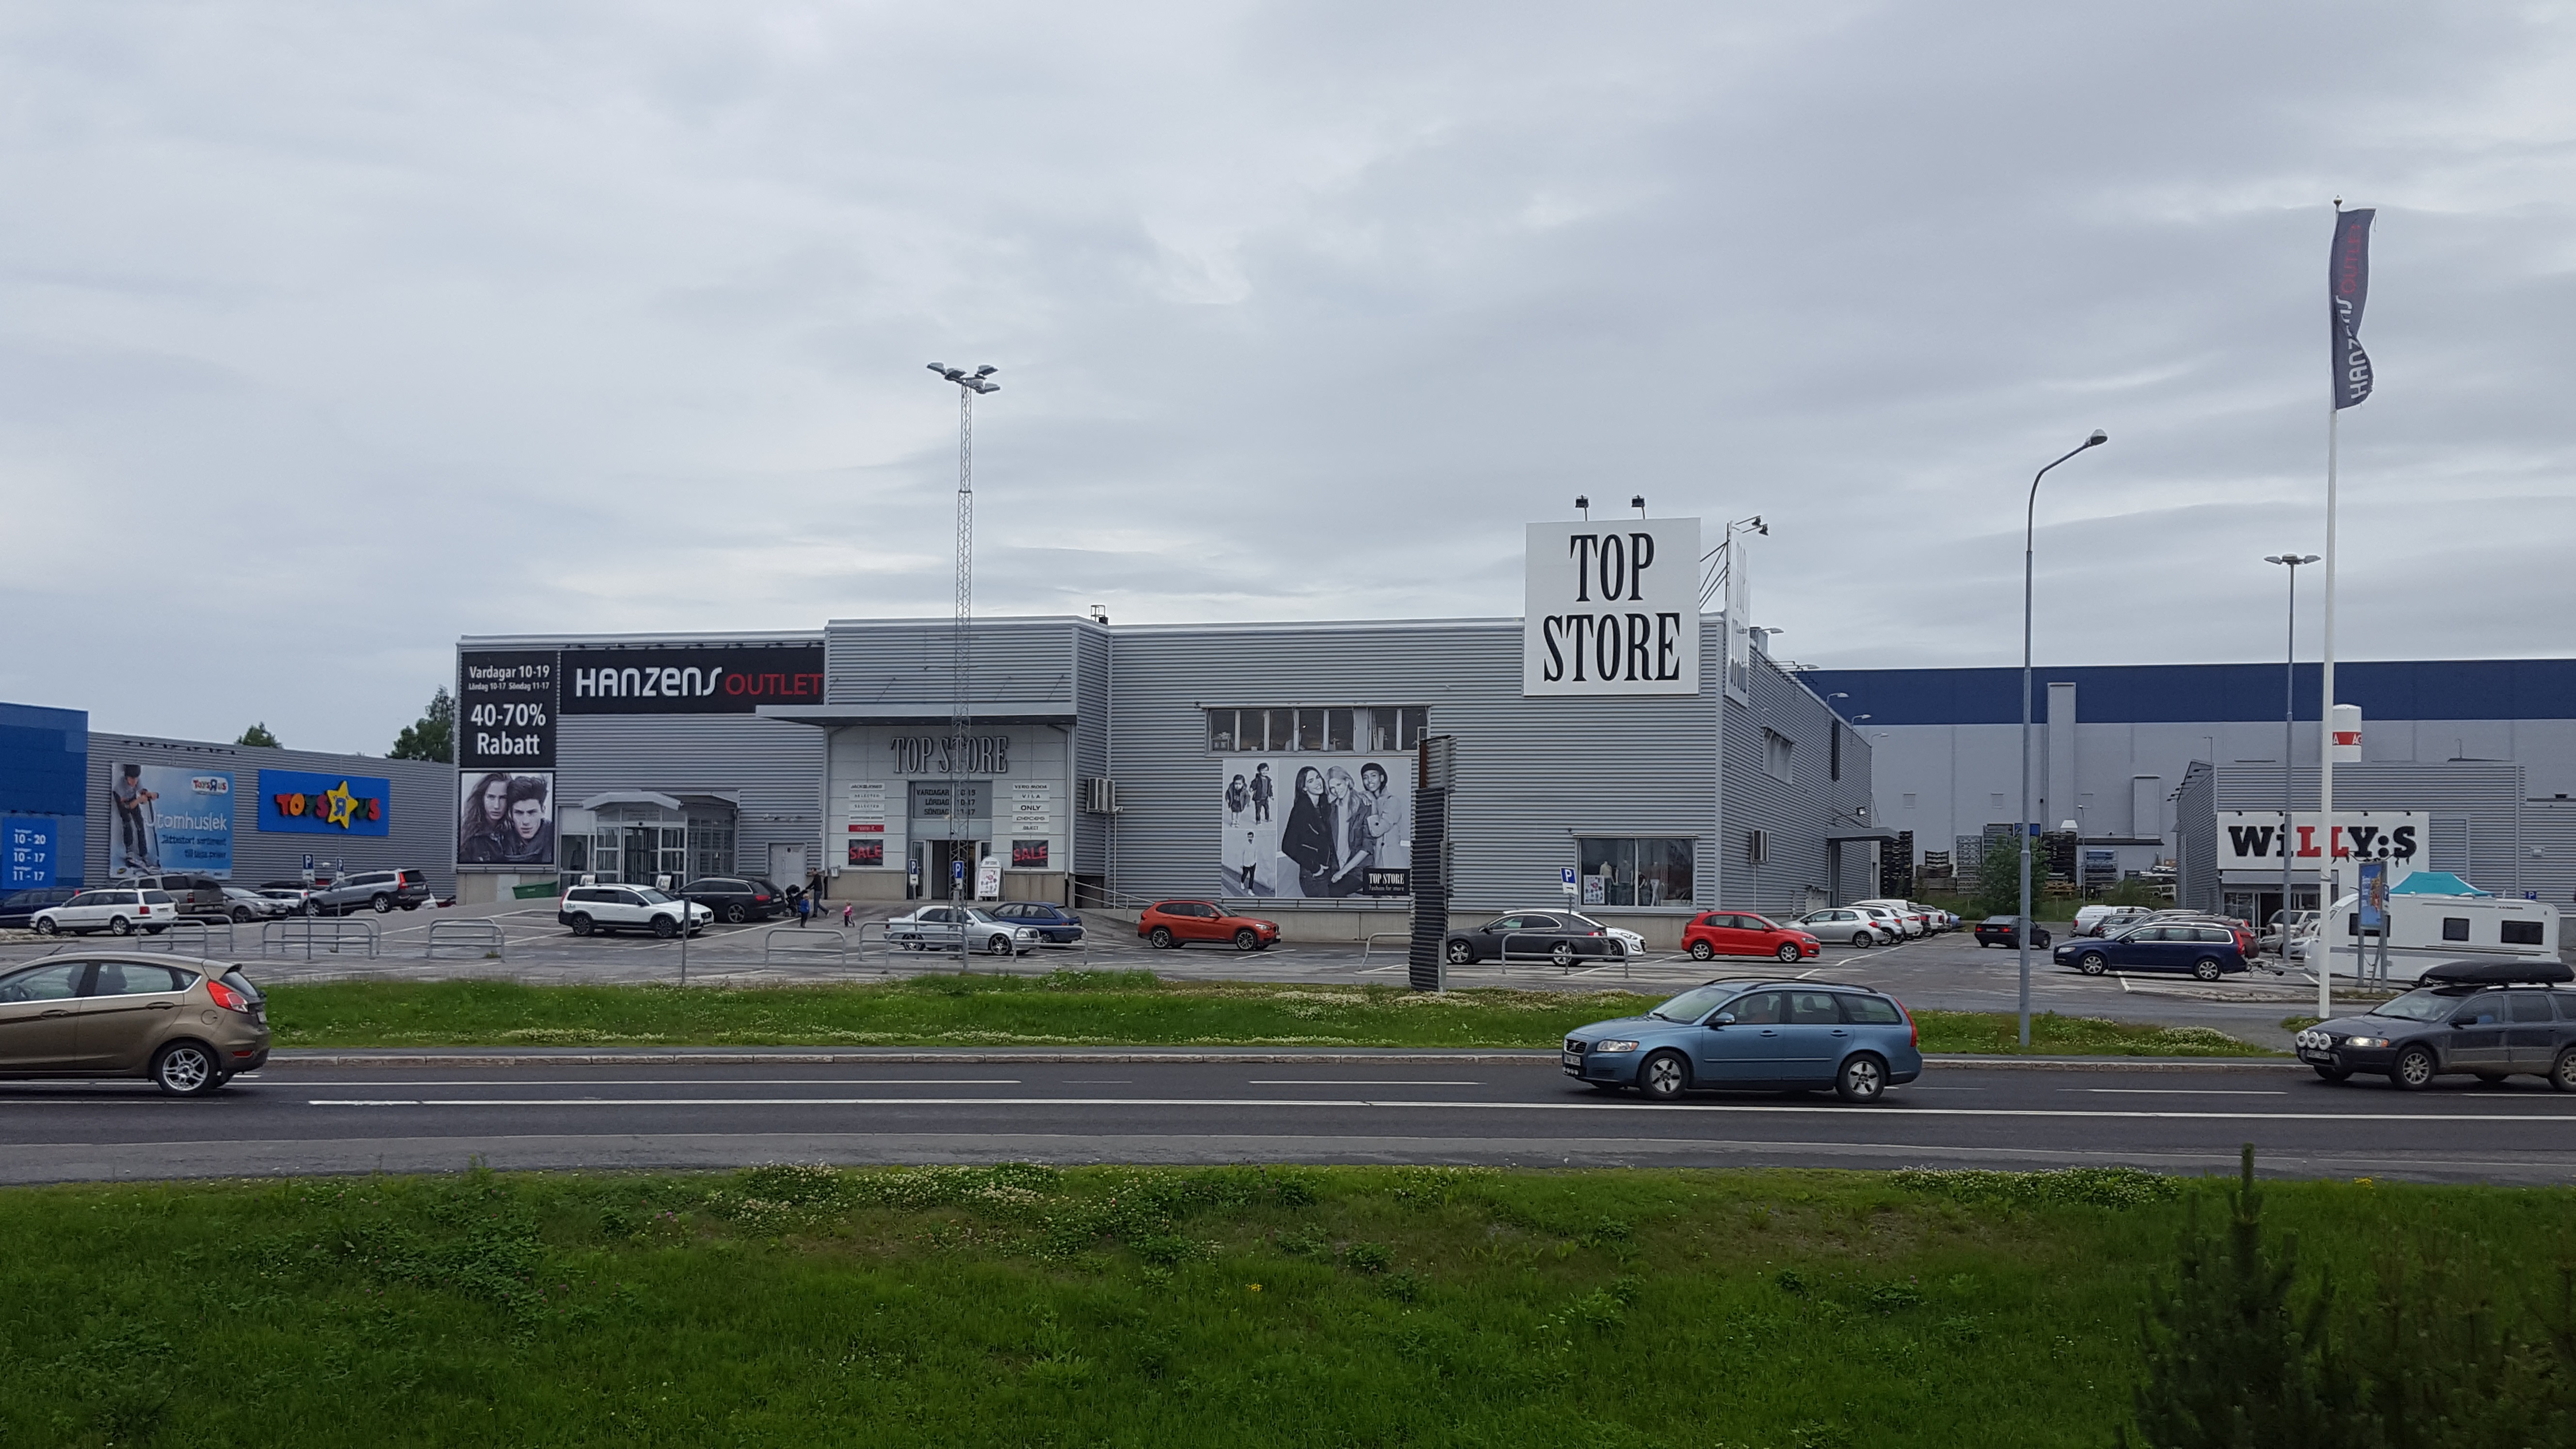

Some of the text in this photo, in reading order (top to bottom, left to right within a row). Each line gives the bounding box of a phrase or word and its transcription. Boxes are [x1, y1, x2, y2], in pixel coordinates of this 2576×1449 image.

[2341, 224, 2361, 294] OUTLET
[1570, 532, 1654, 602] TOP
[1543, 613, 1680, 682] STORE
[469, 665, 550, 681] Vardagar 10-19
[468, 682, 488, 692] Lördag
[509, 682, 531, 692] Söndag
[725, 673, 823, 695] OUTLET
[470, 703, 546, 726] 40-70%
[477, 731, 540, 755] Rabatt
[891, 736, 1008, 773] TOP STORE
[144, 811, 227, 831] Utomhuslek
[14, 834, 26, 844] 10
[33, 834, 46, 844] 20
[14, 852, 25, 862] 10
[34, 853, 45, 862] 17
[850, 845, 883, 860] SALE
[1014, 846, 1048, 861] SALE
[305, 855, 311, 869] P
[338, 859, 342, 870] P
[912, 861, 916, 873] P
[13, 871, 23, 881] 11
[34, 871, 45, 881] 17
[955, 864, 961, 877] P
[1565, 869, 1572, 882] P
[1368, 873, 1404, 884] TOP STORE
